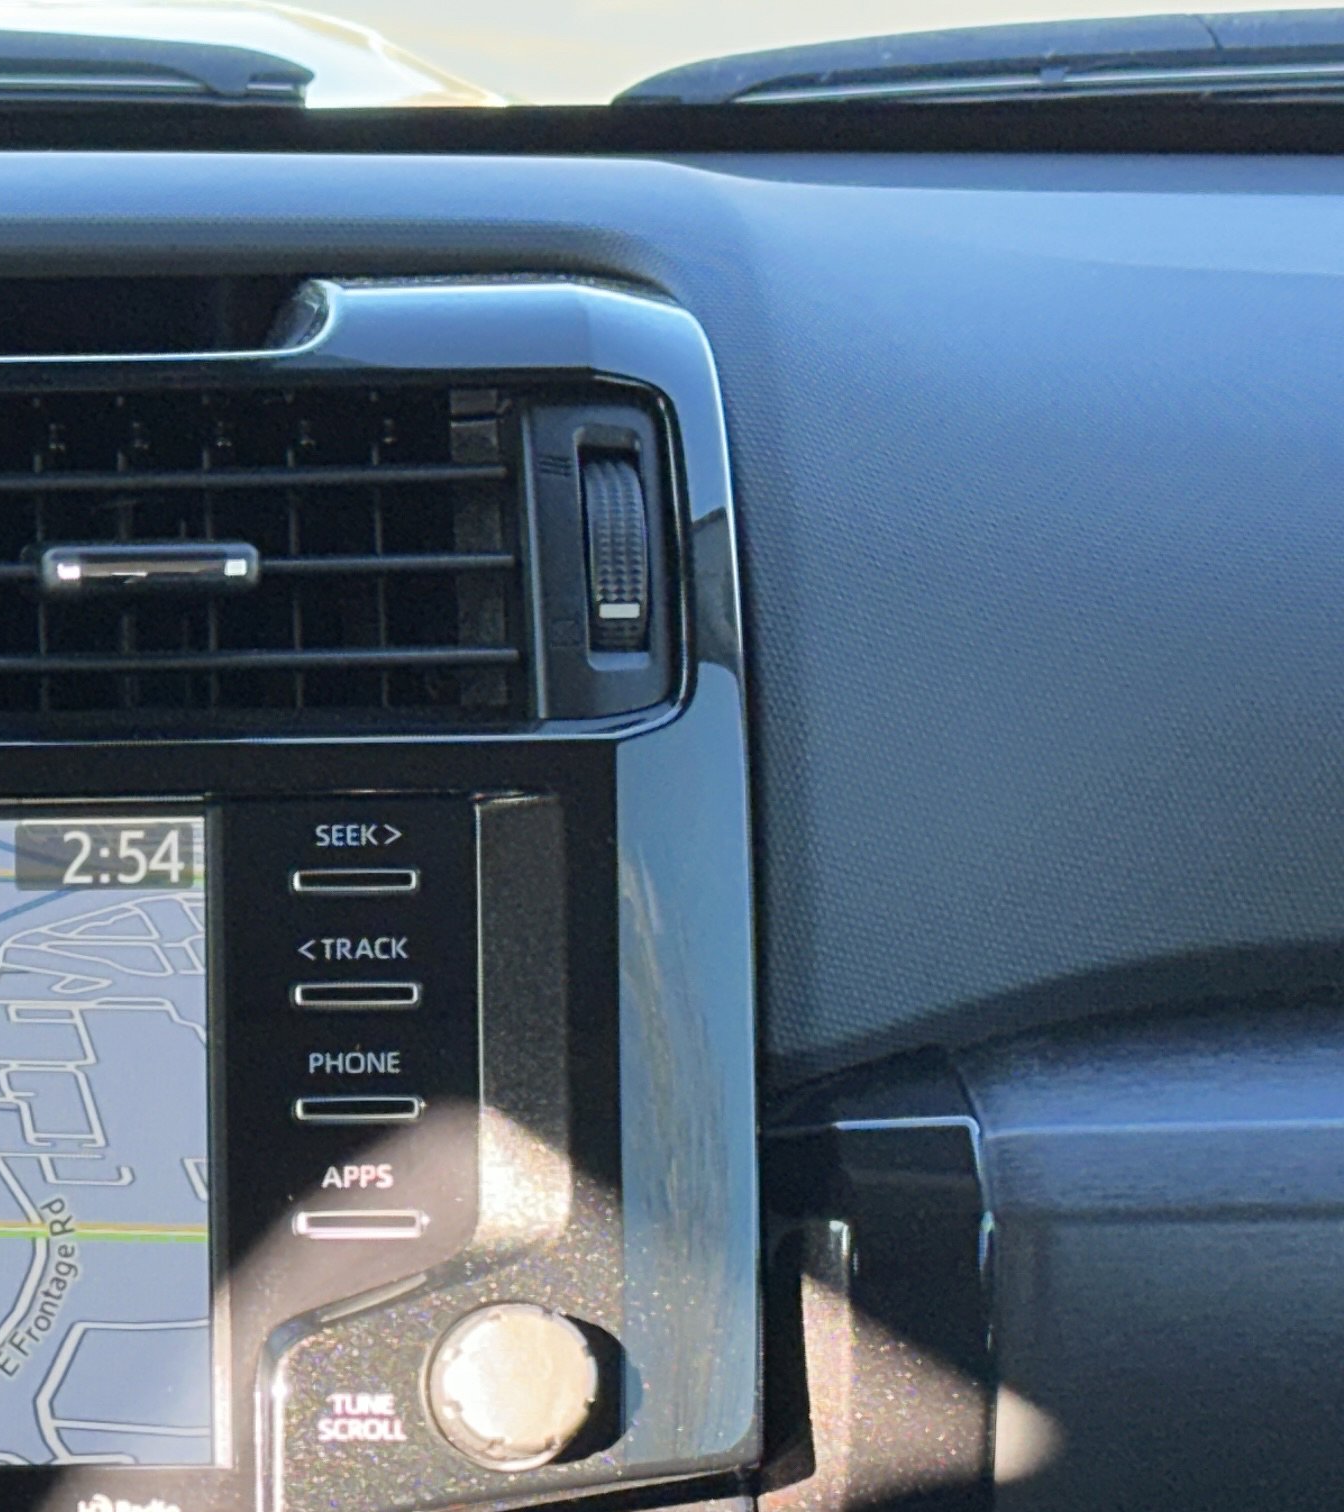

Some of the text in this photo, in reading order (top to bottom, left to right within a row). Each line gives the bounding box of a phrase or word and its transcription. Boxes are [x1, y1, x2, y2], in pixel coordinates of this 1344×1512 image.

[61, 829, 185, 885] 2:54
[321, 936, 409, 961] TRACK
[308, 1051, 401, 1075] PHONE
[320, 1163, 394, 1189] APPS
[40, 1196, 76, 1241] Rd
[10, 1243, 79, 1358] Frontage
[325, 1391, 397, 1416] TUNE
